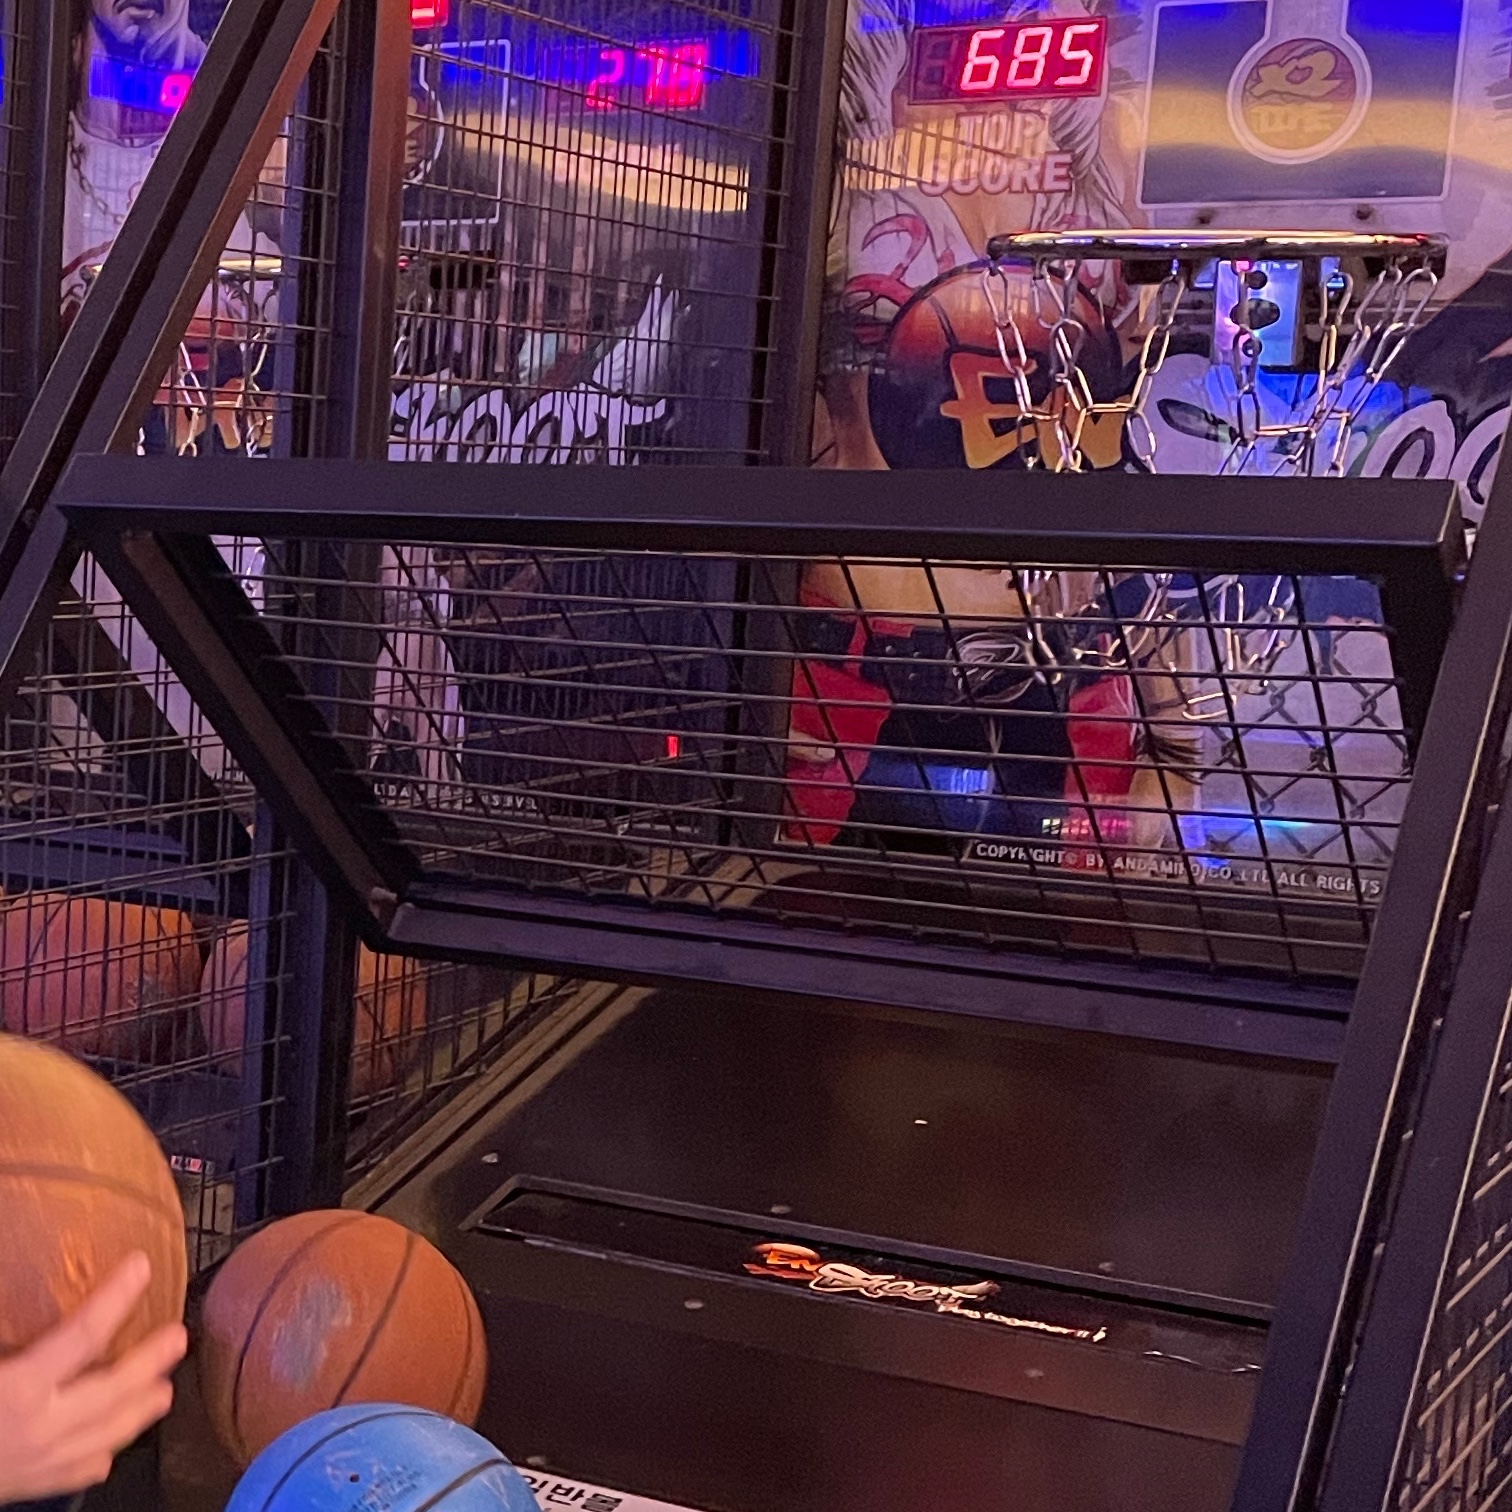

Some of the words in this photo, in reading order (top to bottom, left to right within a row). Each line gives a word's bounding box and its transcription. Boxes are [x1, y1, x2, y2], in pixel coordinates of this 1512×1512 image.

[960, 23, 1099, 90] 685
[956, 111, 1046, 160] TOP
[919, 151, 1074, 197] SCORE
